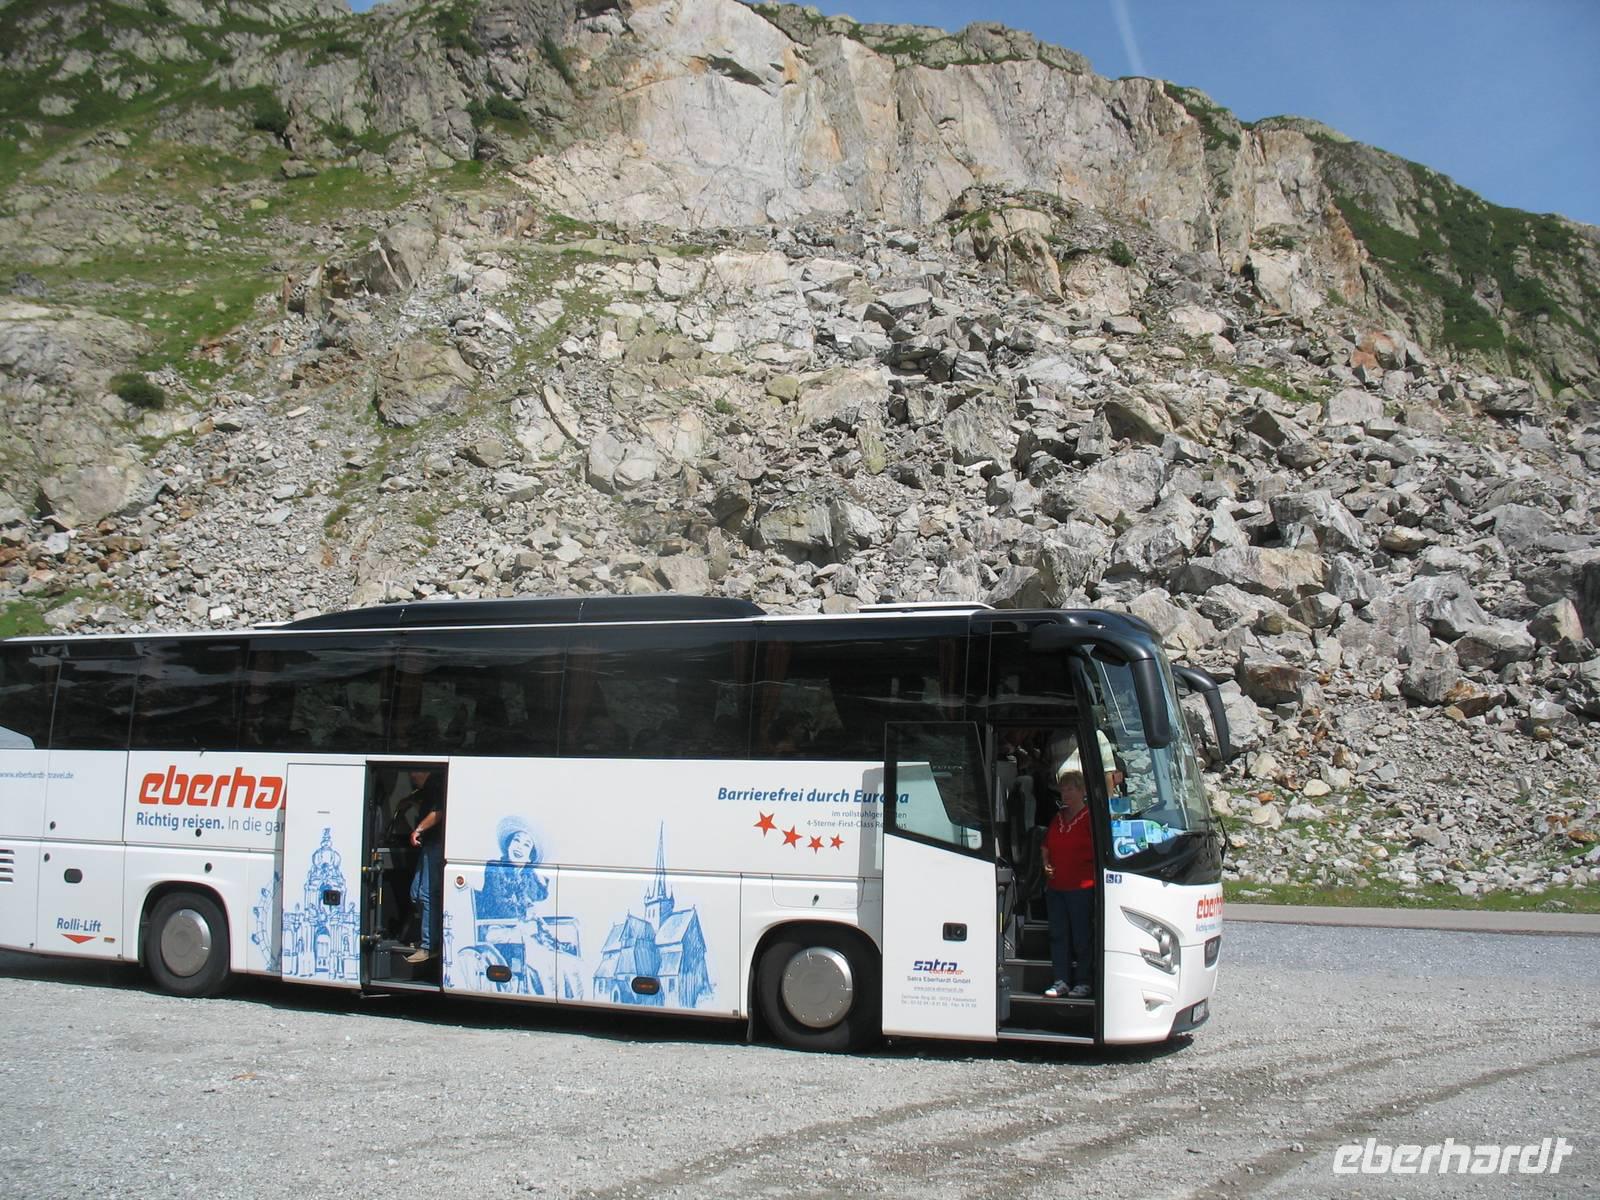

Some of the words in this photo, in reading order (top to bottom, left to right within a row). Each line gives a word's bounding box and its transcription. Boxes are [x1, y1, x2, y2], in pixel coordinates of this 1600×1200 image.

[138, 765, 287, 810] eberha
[718, 787, 804, 802] Barrierefrei
[806, 788, 850, 803] durch
[136, 811, 179, 831] Richtig
[182, 814, 225, 829] reisen.
[228, 816, 239, 830] In
[242, 816, 262, 831] die
[56, 917, 101, 933] Rolli-Lift
[913, 959, 958, 972] satra
[923, 976, 951, 984] Eberhardt
